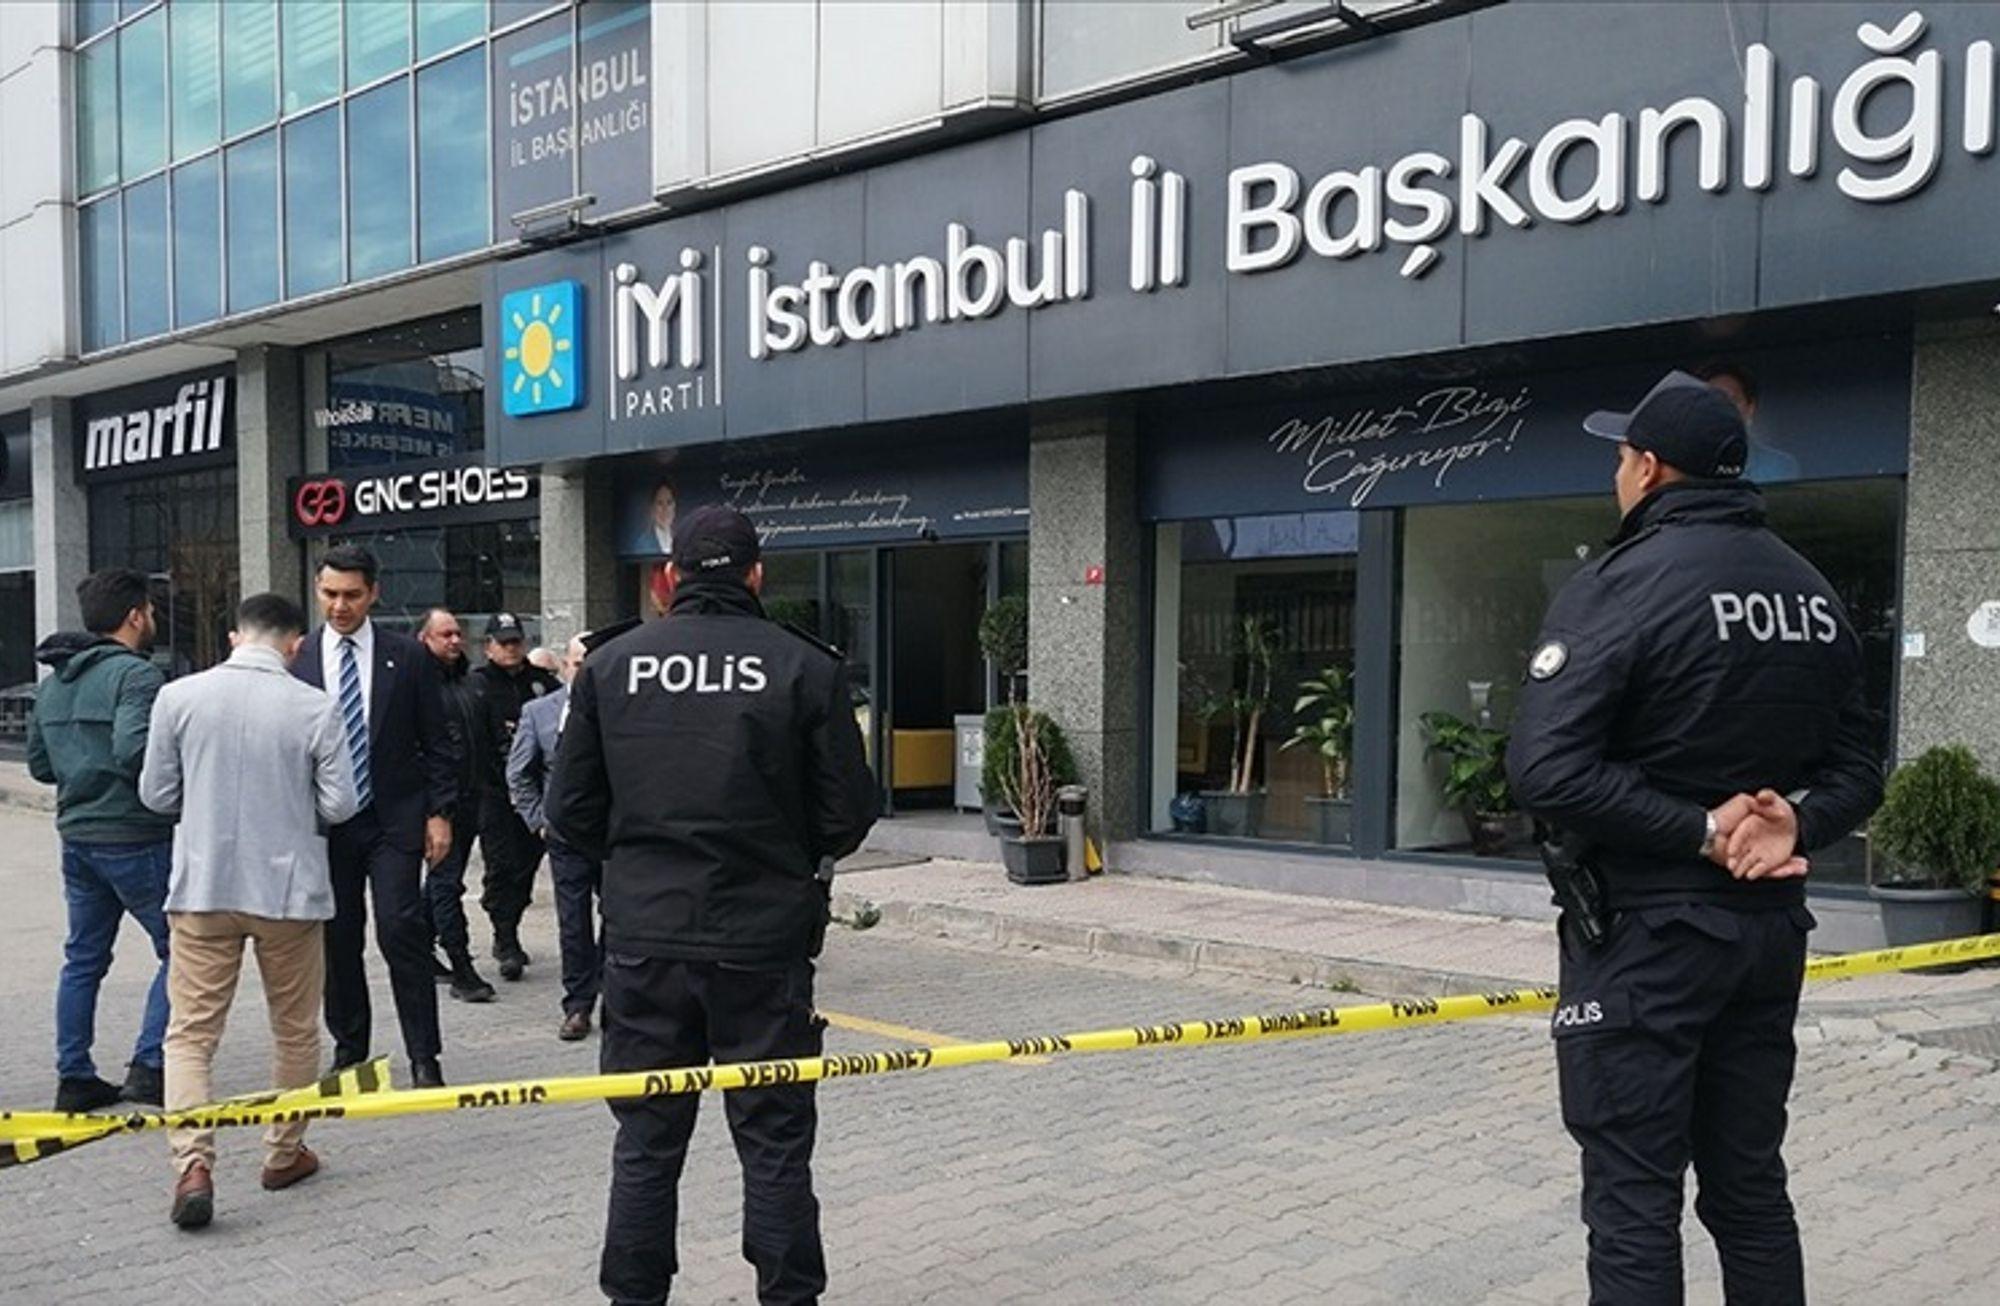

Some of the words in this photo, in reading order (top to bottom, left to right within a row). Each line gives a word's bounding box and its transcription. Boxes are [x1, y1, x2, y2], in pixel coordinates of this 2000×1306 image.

[509, 48, 647, 128] İSTANBUL
[746, 188, 1088, 360] İstanbul
[1130, 155, 1186, 293] İl
[1225, 10, 1994, 278] Başkanlığı
[616, 247, 703, 381] İYİ
[84, 377, 226, 470] marfil
[626, 376, 704, 418] PARTİ
[1268, 406, 1419, 466] Millet
[1412, 386, 1531, 440] Bizi
[354, 475, 414, 515] GNC
[419, 466, 529, 510] SHOES
[1710, 591, 1838, 644] POLİS
[628, 654, 767, 694] POLİS
